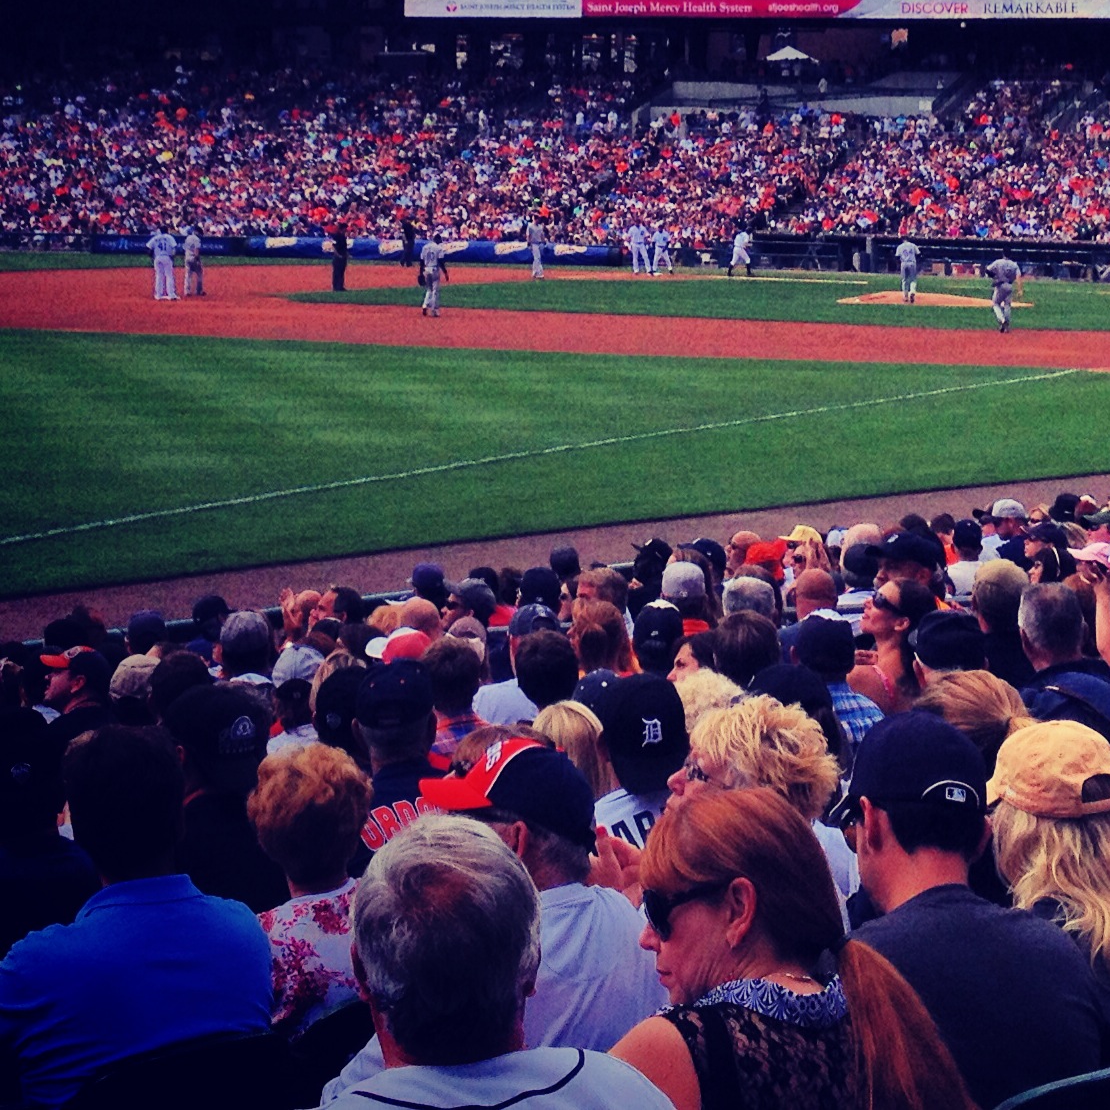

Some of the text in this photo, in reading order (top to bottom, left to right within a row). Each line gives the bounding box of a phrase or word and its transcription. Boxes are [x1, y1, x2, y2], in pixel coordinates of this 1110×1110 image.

[587, 1, 753, 14] Saint Joseph Mercy Health System
[901, 2, 1078, 14] DISCOVER REMARKABLE
